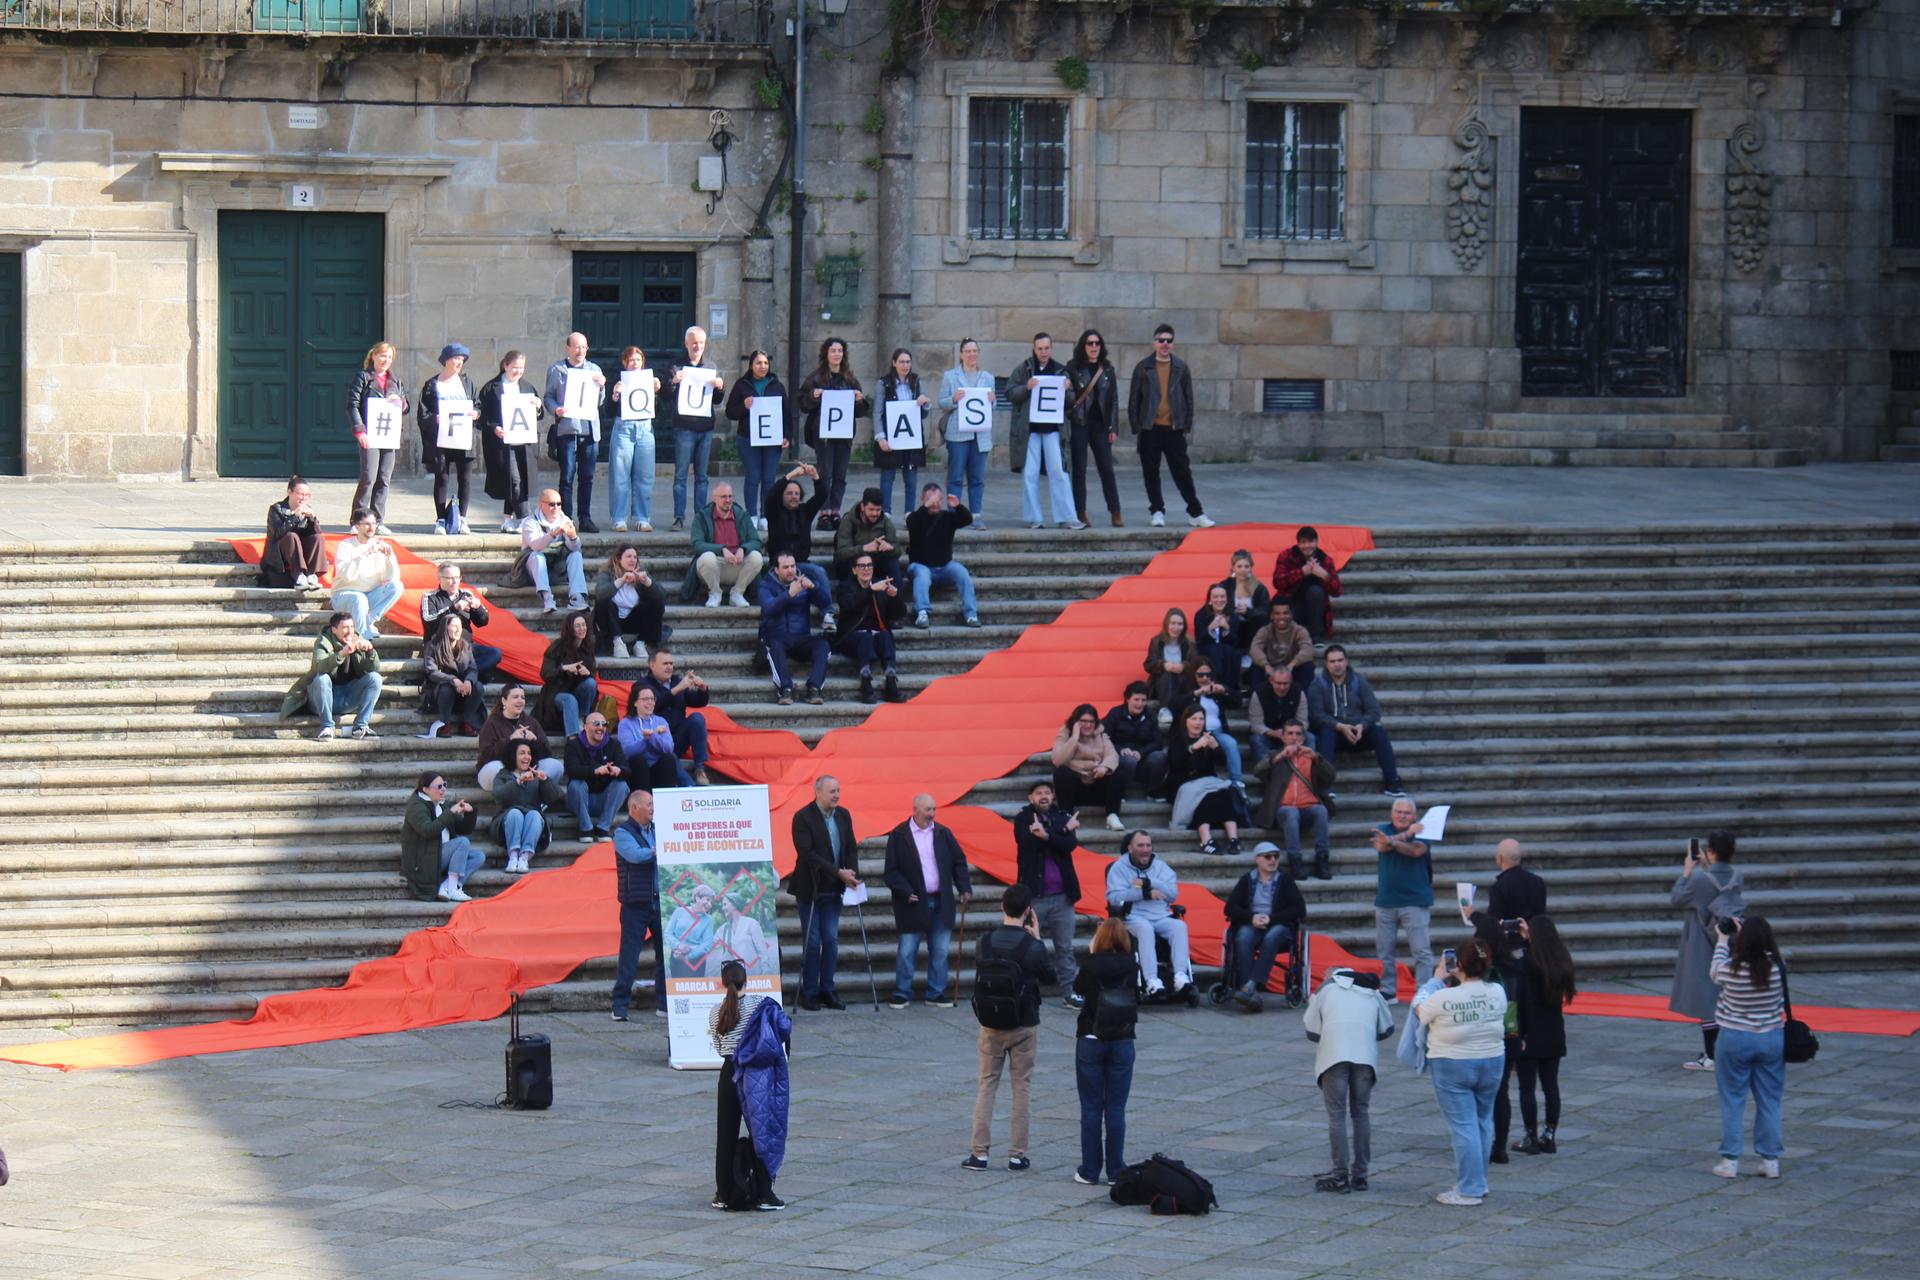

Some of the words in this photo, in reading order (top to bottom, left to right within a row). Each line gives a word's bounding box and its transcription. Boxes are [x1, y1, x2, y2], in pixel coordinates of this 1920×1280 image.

[300, 190, 307, 202] 2
[628, 388, 651, 414] Q
[687, 384, 706, 409] U
[1037, 386, 1058, 413] E
[375, 411, 392, 436] #
[509, 407, 530, 431] A
[828, 407, 843, 432] P
[965, 398, 985, 426] S
[447, 412, 465, 437] F
[758, 414, 772, 439] E
[893, 413, 915, 438] A
[694, 798, 742, 807] SOLIDARIA
[673, 822, 690, 831] NON
[691, 821, 728, 830] ESPERES
[729, 821, 735, 829] A
[736, 820, 752, 829] QUE
[687, 832, 693, 840] O
[694, 831, 706, 839] BO
[707, 830, 739, 839] CHEGUE
[663, 841, 682, 853] FAI
[682, 840, 705, 853] QUE
[706, 839, 765, 851] ACONTEZA
[675, 981, 707, 992] MARCA
[708, 981, 716, 991] A
[745, 980, 773, 989] DARIA
[1442, 1000, 1488, 1011] Country
[1453, 1010, 1480, 1023] Club
